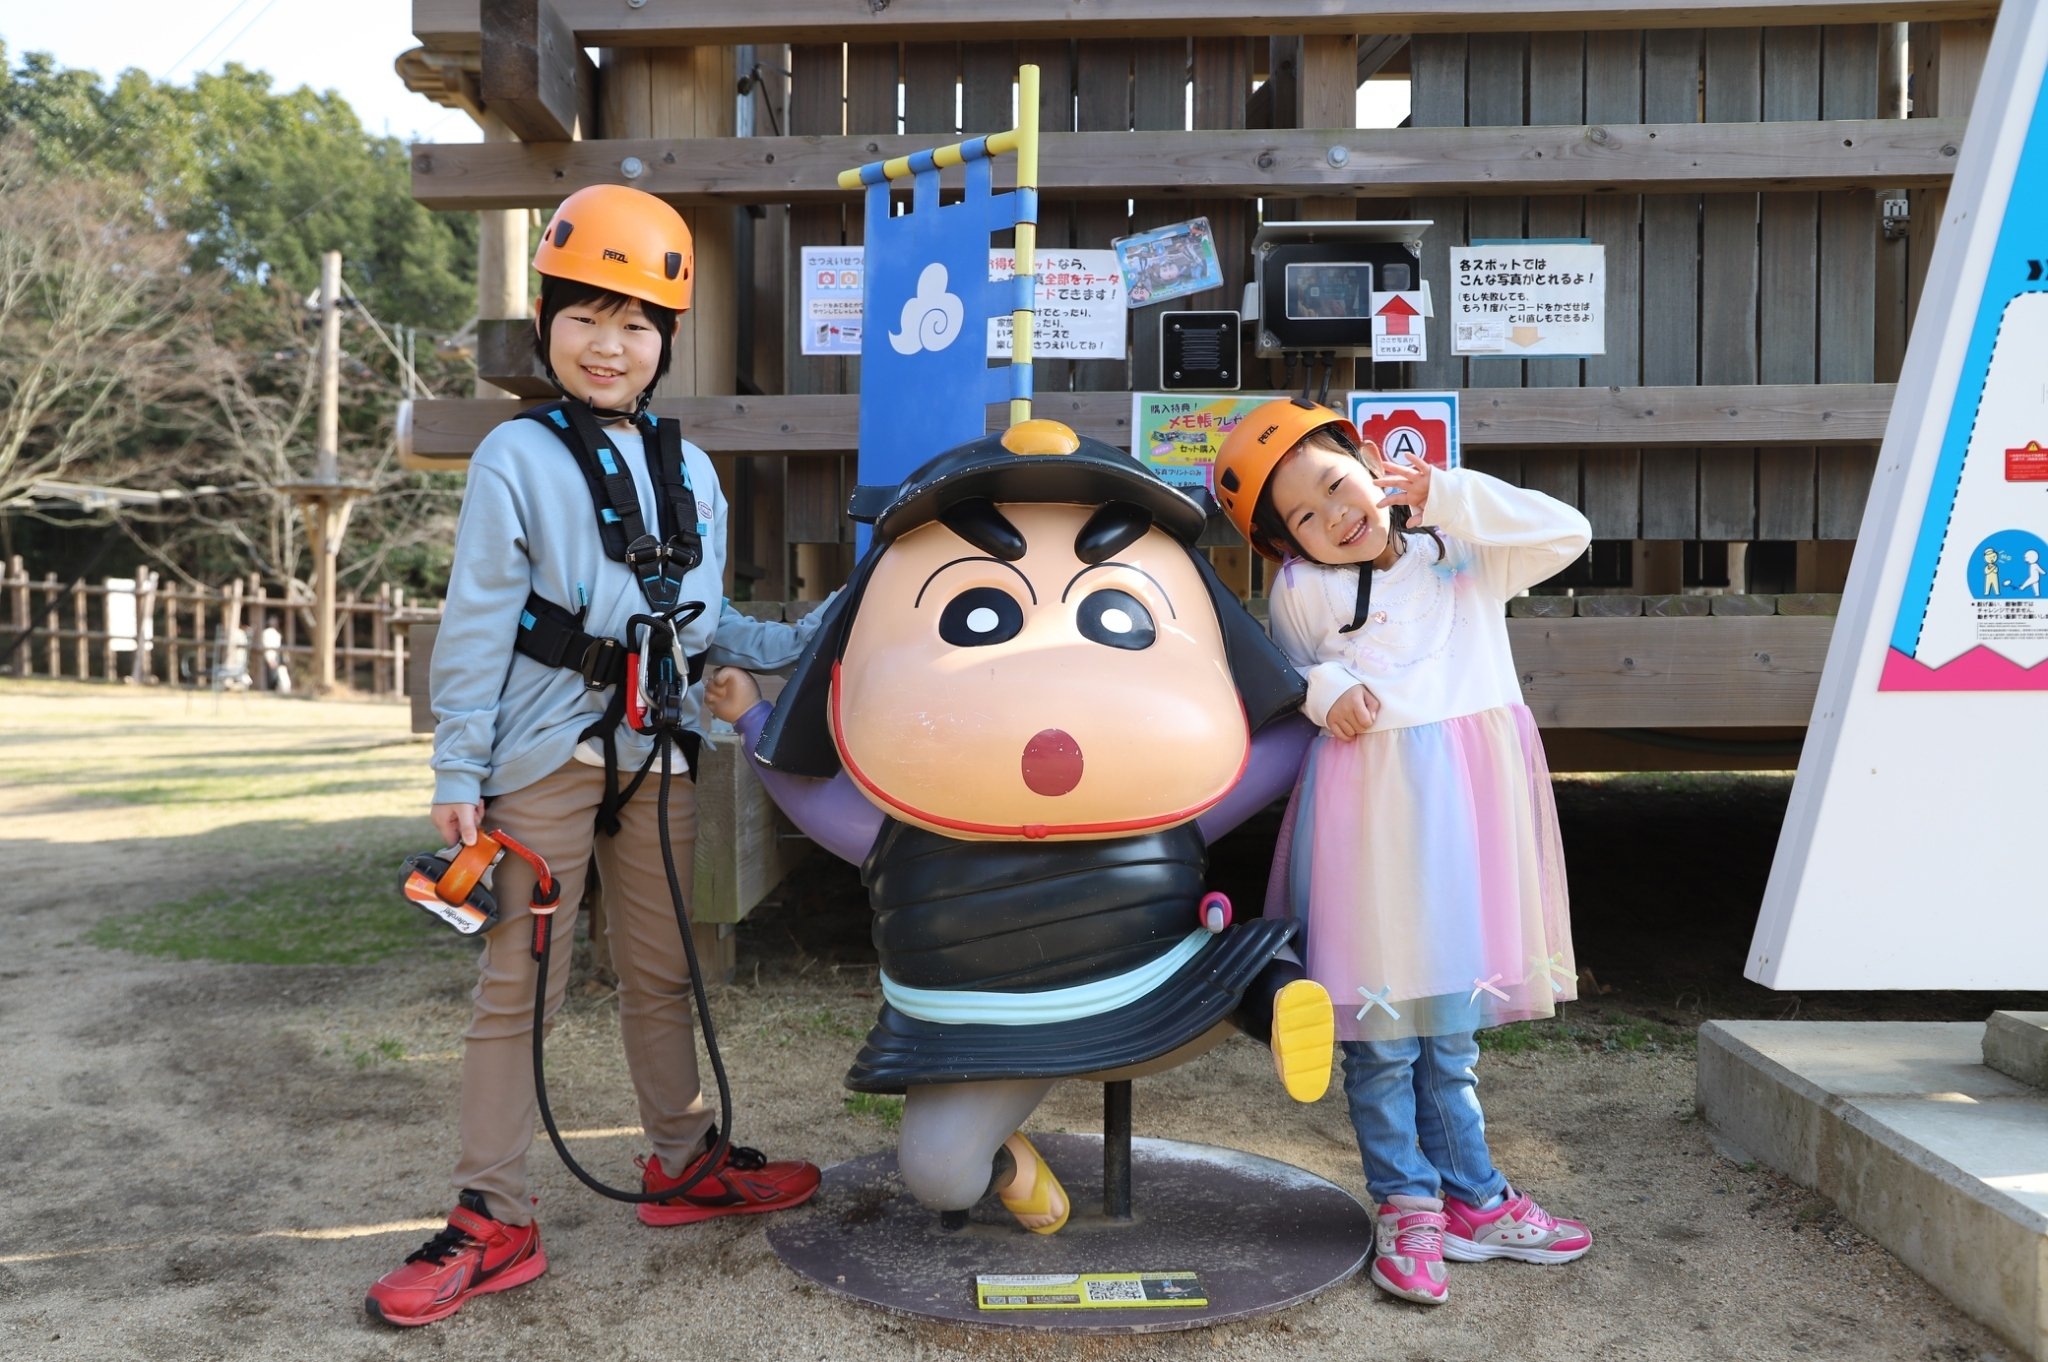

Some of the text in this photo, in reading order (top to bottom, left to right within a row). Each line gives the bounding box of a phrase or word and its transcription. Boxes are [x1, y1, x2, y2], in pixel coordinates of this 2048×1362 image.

[602, 249, 628, 264] PETZL
[808, 257, 864, 266] さつえいせつ
[1459, 258, 1547, 272] 各スポットでは
[1459, 273, 1594, 286] こんな写真がとれるよ！
[1257, 425, 1279, 445] PETZL
[1180, 444, 1217, 454] セット購入
[1392, 433, 1416, 458] A
